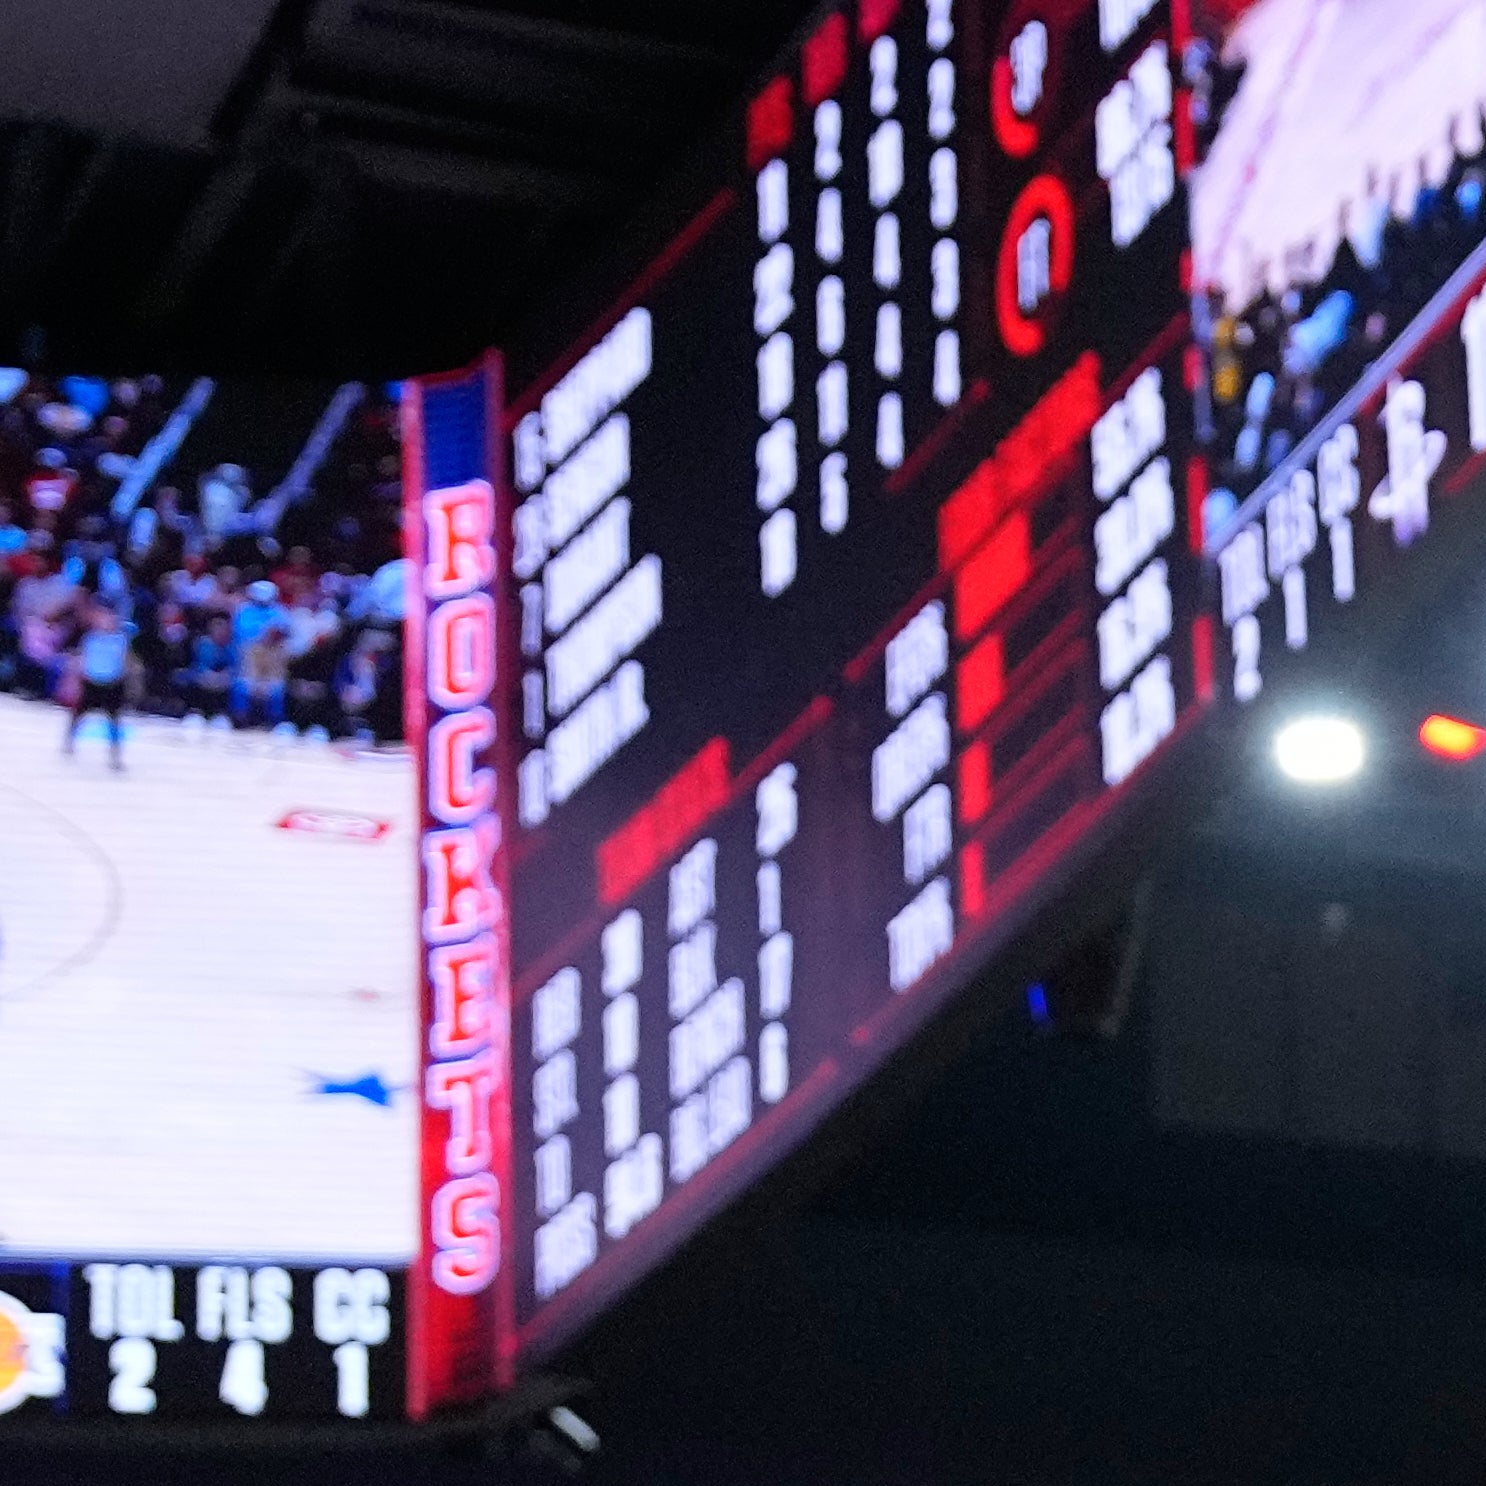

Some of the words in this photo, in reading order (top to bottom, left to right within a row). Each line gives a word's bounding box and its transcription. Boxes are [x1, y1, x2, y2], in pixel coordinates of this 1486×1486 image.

[421, 478, 502, 1296] ROCKETS
[82, 1263, 186, 1342] TOL
[196, 1265, 294, 1345] FLS
[312, 1267, 391, 1346] CC
[107, 1338, 157, 1414] 2
[218, 1340, 268, 1416] 4
[332, 1341, 370, 1418] 1
